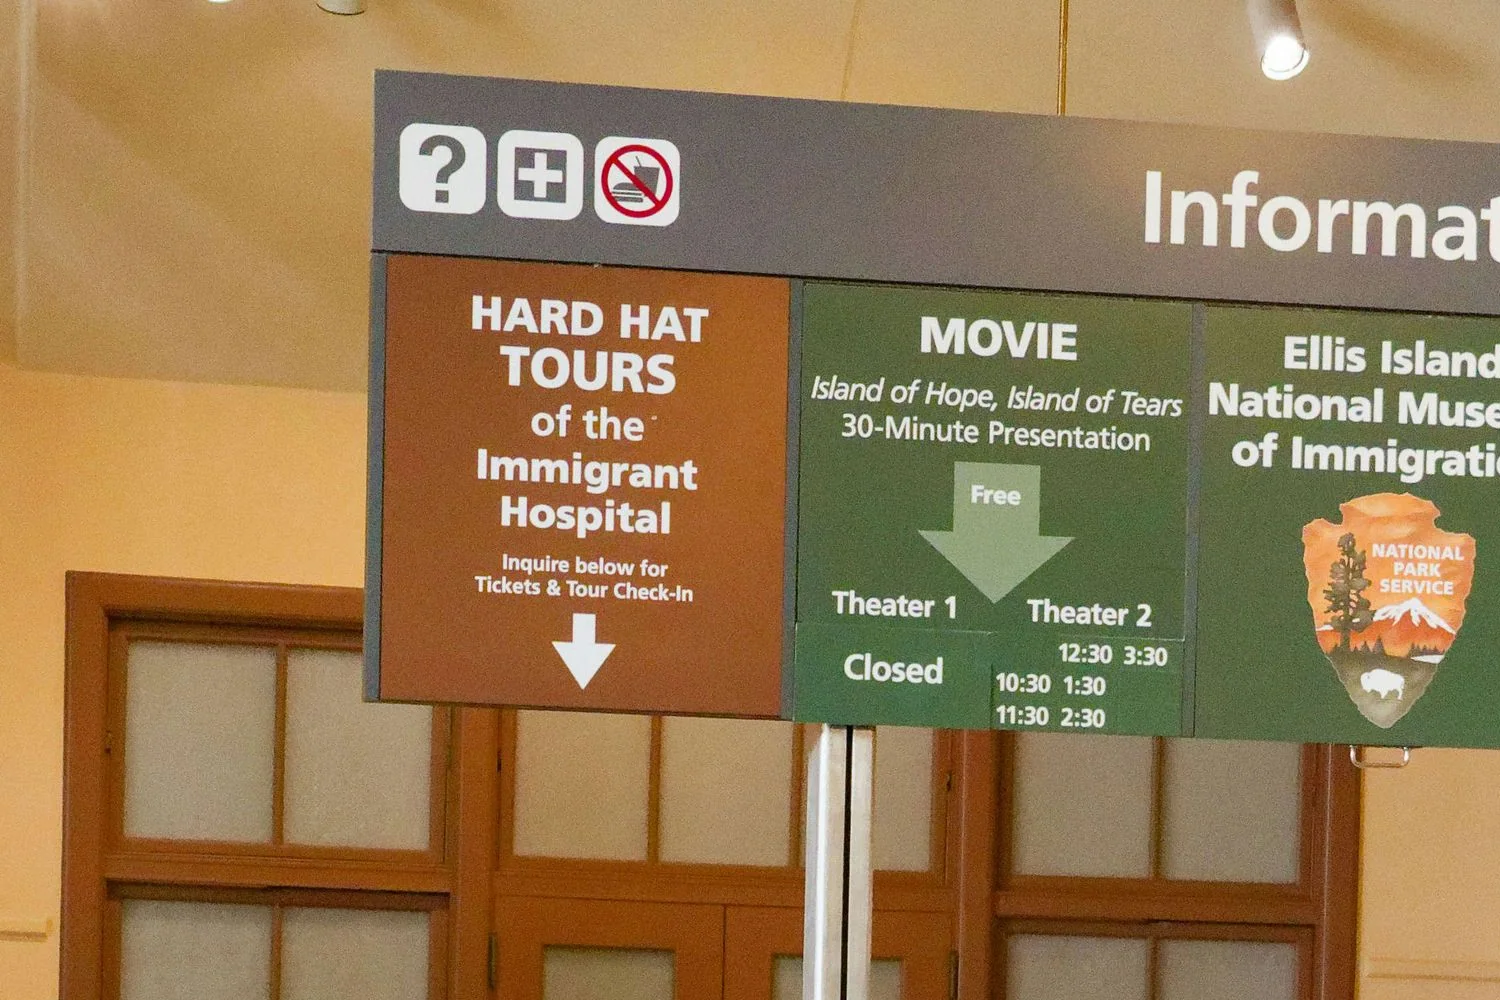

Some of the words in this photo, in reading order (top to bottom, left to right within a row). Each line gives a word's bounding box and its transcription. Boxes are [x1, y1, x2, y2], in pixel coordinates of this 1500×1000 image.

[471, 294, 604, 337] HARD
[620, 303, 710, 343] HAT
[920, 316, 1078, 361] MOVIE
[1284, 334, 1367, 373] Ellis
[499, 345, 676, 395] TOURS
[810, 374, 886, 402] Island
[890, 378, 922, 404] of
[924, 381, 998, 413] Hope,
[1007, 385, 1081, 412] Island
[1085, 388, 1116, 414] of
[1120, 390, 1183, 417] Tears
[1208, 382, 1384, 423] National
[531, 403, 572, 437] of
[582, 406, 645, 442] the
[841, 413, 980, 444] 30-Minute
[988, 420, 1151, 452] Presentation
[1231, 431, 1279, 468] of
[477, 448, 698, 495] Immigrant
[971, 484, 1021, 506] Free
[501, 495, 671, 539] Hospital
[502, 553, 570, 576] Inquire
[575, 555, 635, 576] below
[639, 558, 669, 578] for
[1373, 544, 1464, 560] NATIONAL
[1394, 562, 1440, 576] PARK
[474, 575, 541, 596] Tickets
[546, 579, 561, 597] &
[565, 579, 609, 598] Tour
[613, 581, 694, 602] Check-In
[1380, 579, 1453, 594] SERVICE
[831, 589, 936, 618] Theater
[944, 595, 956, 619] 1
[1026, 598, 1129, 626] Theater
[1136, 603, 1152, 628] 2
[843, 652, 944, 685] Closed
[1058, 642, 1113, 664] 12:30
[1123, 645, 1168, 667] 3:30
[996, 672, 1052, 694] 10:30
[1063, 675, 1107, 696] 1:30
[996, 704, 1050, 726] 11:30
[1060, 707, 1106, 729] 2:30
